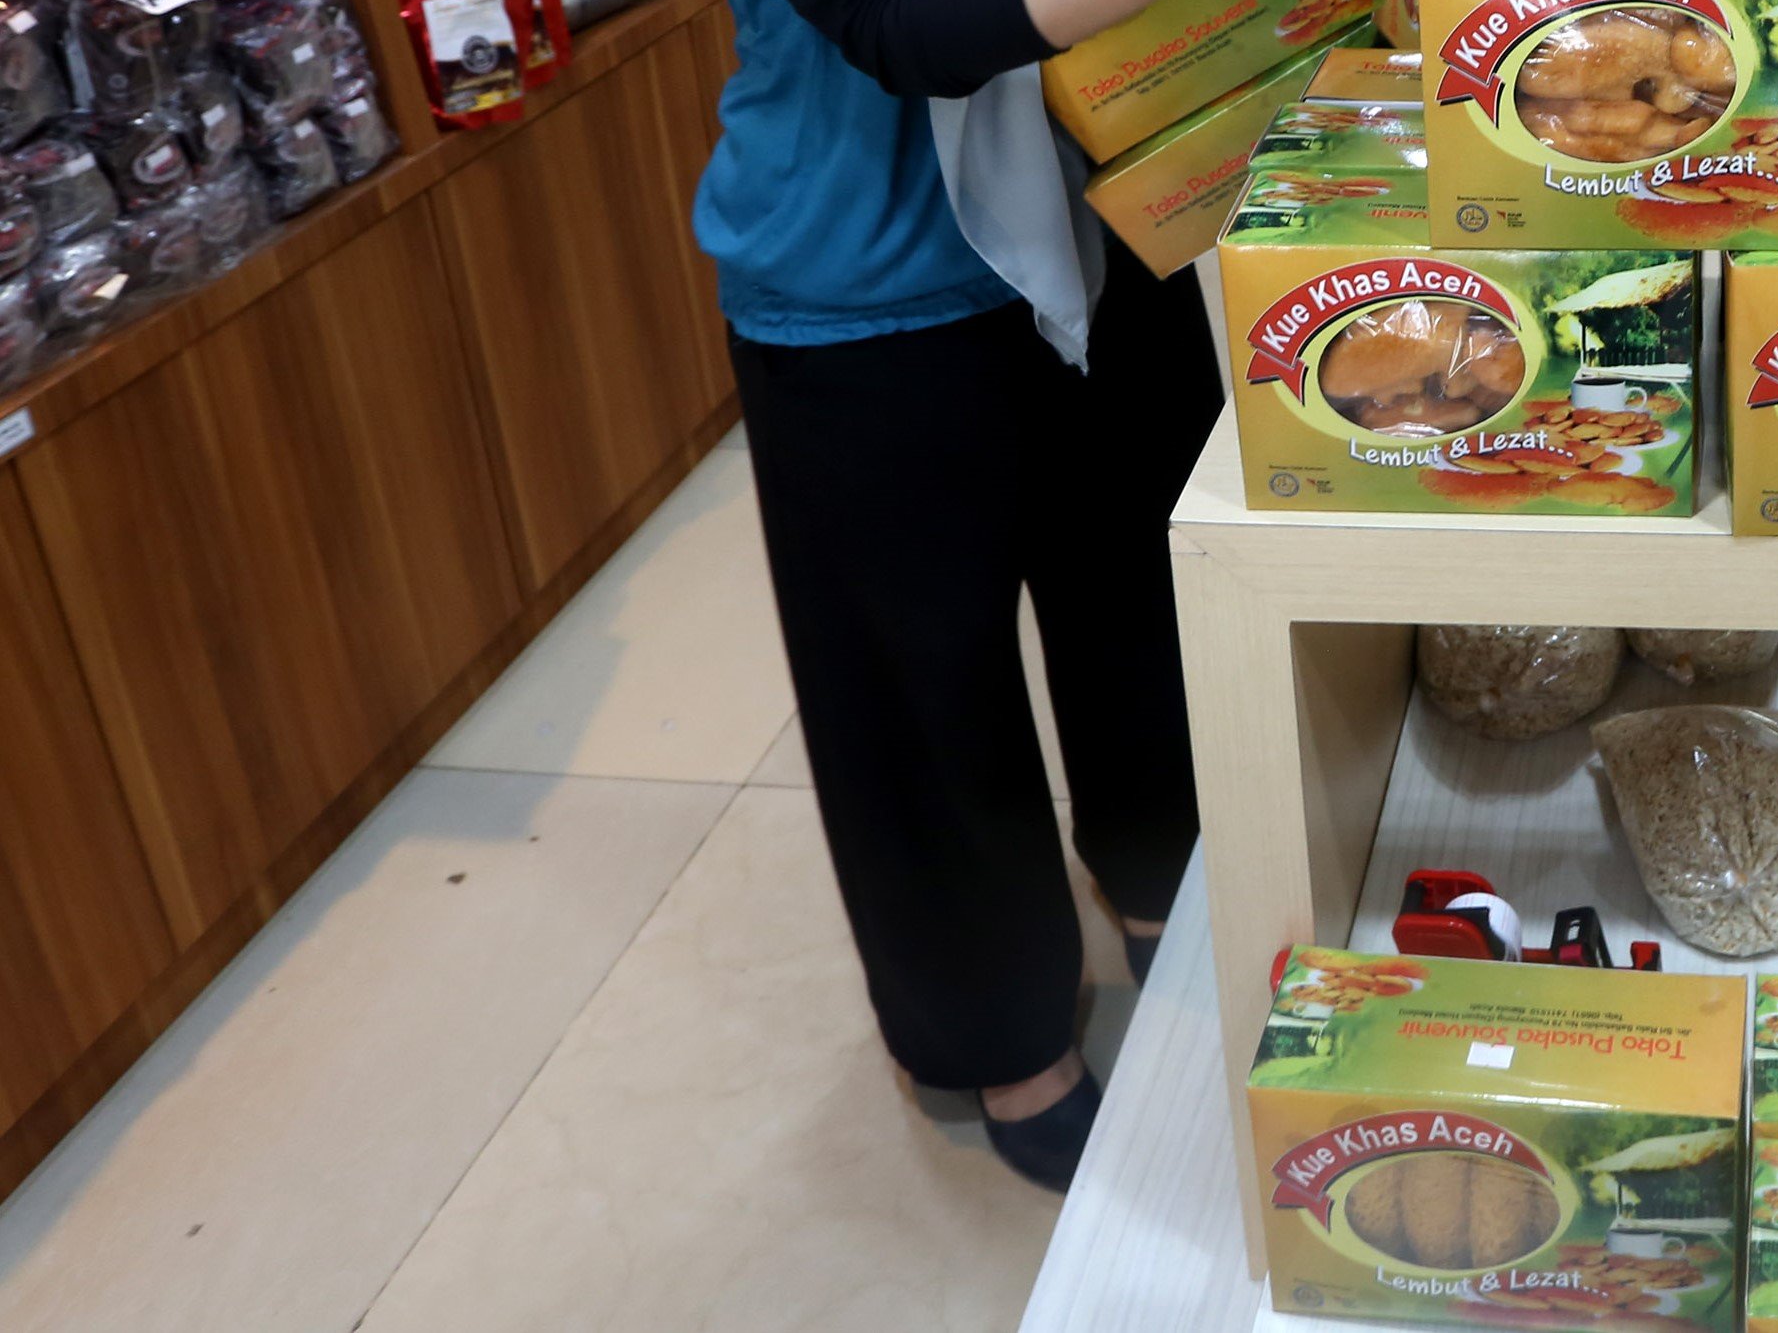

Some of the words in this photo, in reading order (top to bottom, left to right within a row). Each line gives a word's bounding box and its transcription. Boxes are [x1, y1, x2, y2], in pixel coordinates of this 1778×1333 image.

[1454, 11, 1509, 70] Kue
[1077, 74, 1125, 104] Toko
[1121, 34, 1187, 84] Pusaka
[1543, 163, 1643, 198] Lembut
[1651, 161, 1674, 184] &
[1143, 191, 1189, 220] Toko
[1261, 306, 1311, 356] Kue
[1308, 271, 1390, 307] Khas
[1399, 262, 1482, 298] Aceh
[1348, 436, 1442, 467] Lembut
[1449, 436, 1471, 457] &
[1478, 428, 1574, 459] Lezat...
[1396, 1020, 1512, 1048] Souvenir
[1516, 1028, 1614, 1054] Pusaka
[1621, 1035, 1686, 1061] Toko
[1287, 1147, 1335, 1188] Kue
[1337, 1118, 1419, 1157] Khas
[1428, 1114, 1514, 1157] Aceh
[1376, 1265, 1473, 1299] Lembut
[1479, 1272, 1502, 1293] &
